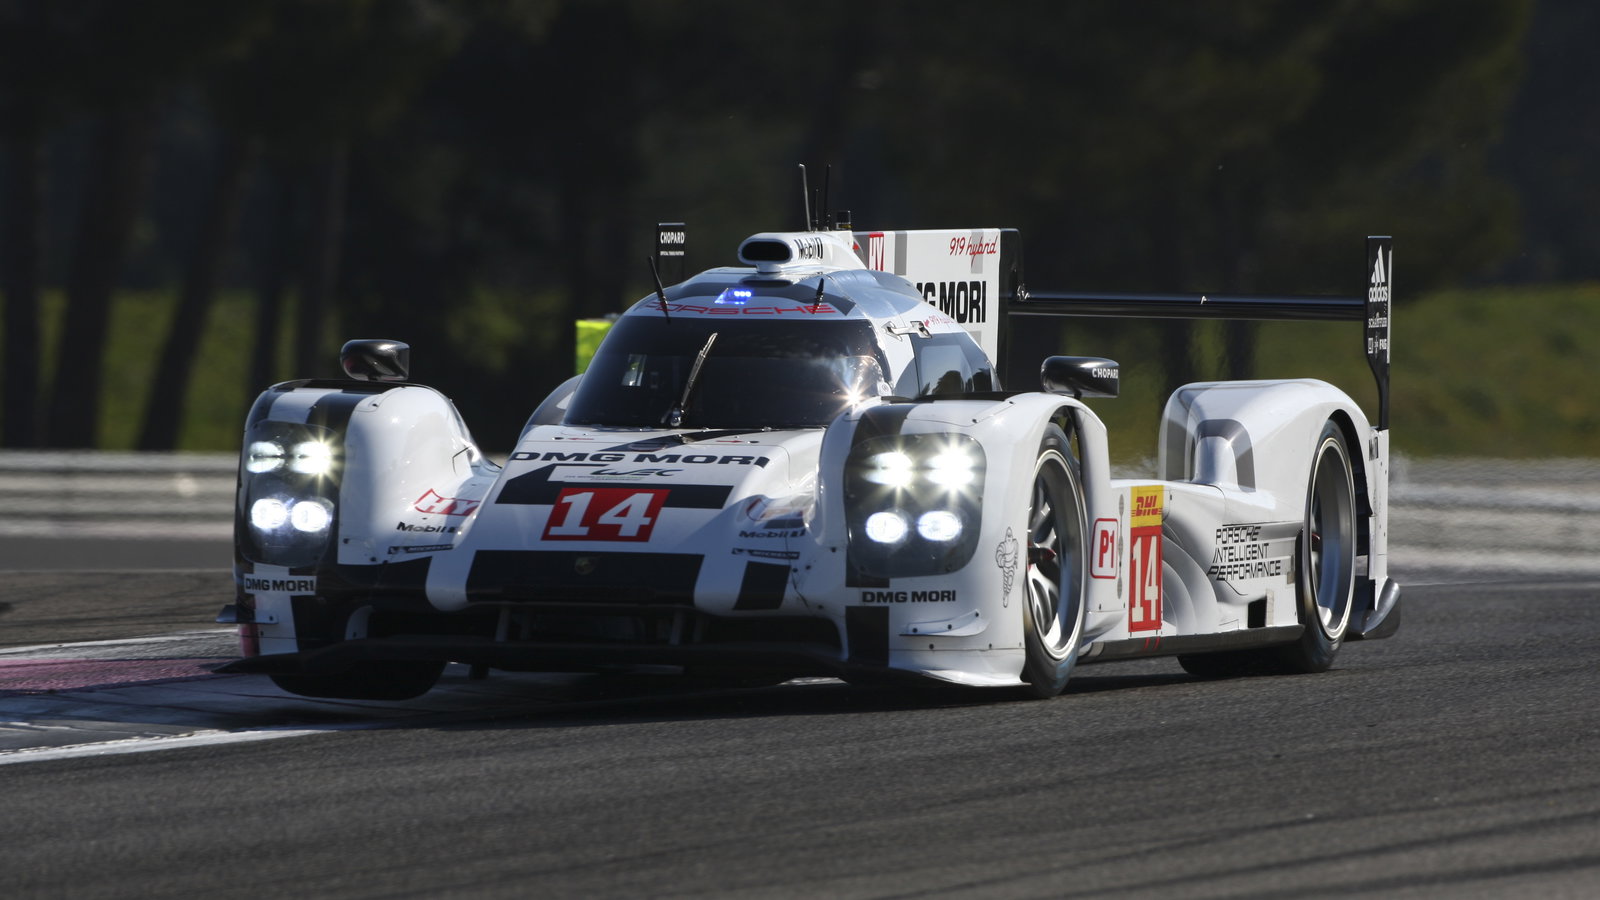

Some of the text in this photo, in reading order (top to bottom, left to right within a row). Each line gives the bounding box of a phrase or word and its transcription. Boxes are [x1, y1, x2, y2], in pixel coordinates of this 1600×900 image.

[660, 232, 685, 244] CHOPARD
[950, 233, 999, 267] 919 hybrid
[939, 281, 987, 323] MORI
[1368, 282, 1388, 303] adidas
[1092, 368, 1119, 379] CHOPARD
[510, 452, 770, 469] DMG MORI
[548, 491, 656, 537] 14
[1136, 495, 1158, 516] DHL
[396, 522, 446, 533] Mobil
[739, 530, 788, 538] Mobil
[1216, 526, 1261, 545] PORSCHE
[1098, 530, 1115, 568] P1
[1213, 543, 1269, 563] INTELLIGENT
[1131, 535, 1159, 622] 14
[1206, 560, 1281, 580] PERFORMANCE
[246, 578, 315, 591] DMG MORI
[862, 590, 956, 603] DMG MORI
